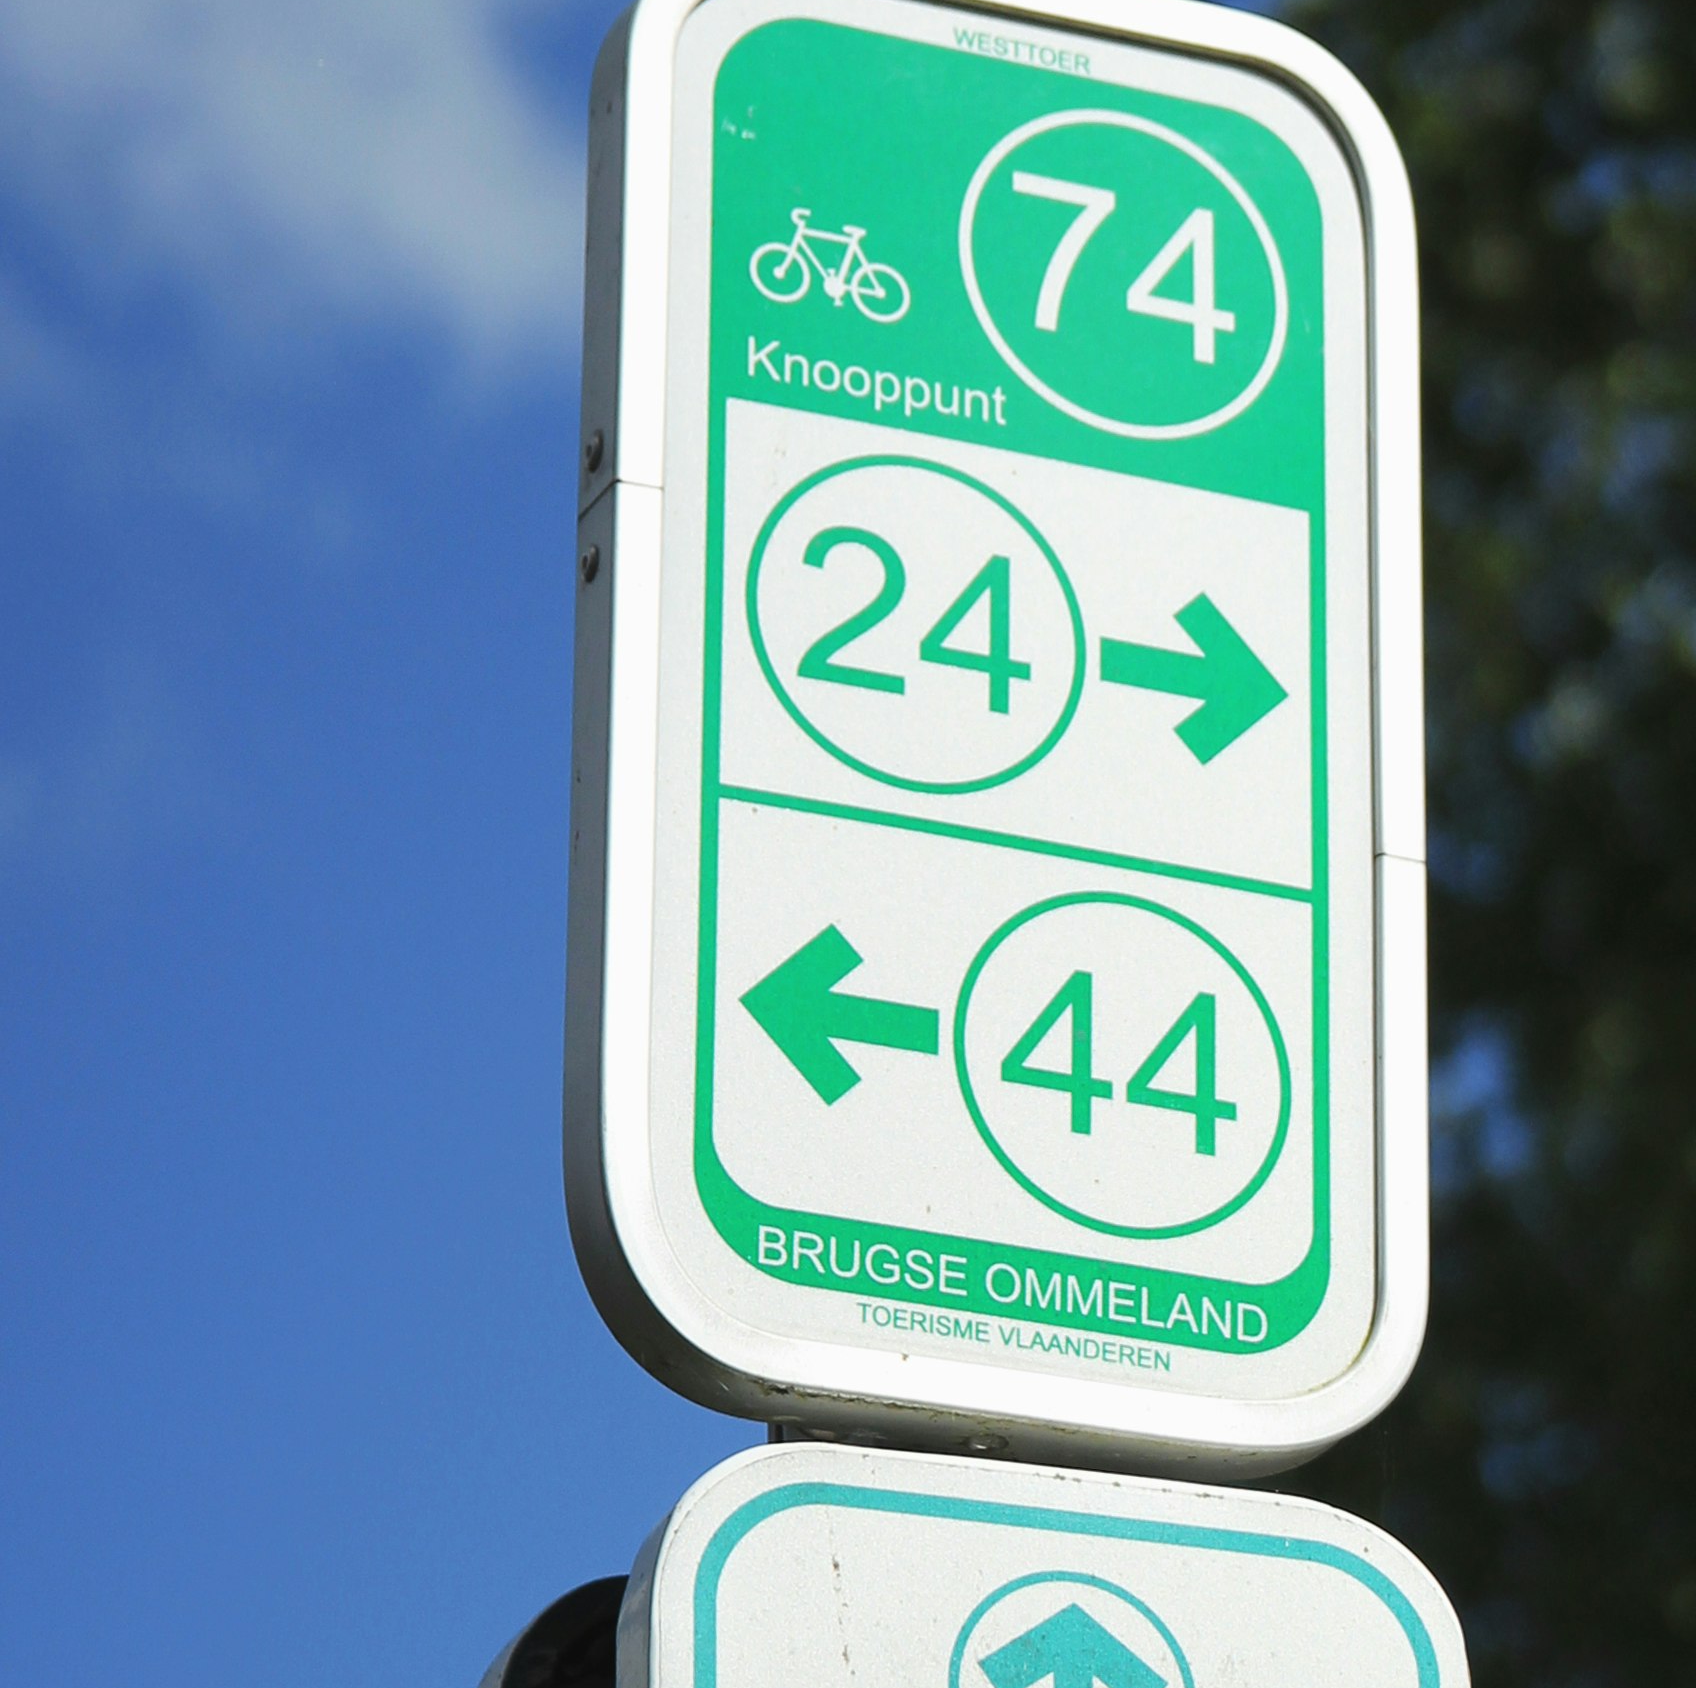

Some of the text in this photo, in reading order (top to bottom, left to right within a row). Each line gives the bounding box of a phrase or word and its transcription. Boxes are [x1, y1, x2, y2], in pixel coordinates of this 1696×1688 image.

[953, 26, 1091, 75] WESTTOER
[1011, 171, 1237, 365] 74
[747, 335, 1007, 426] Knooppunt
[796, 525, 1032, 716] 24
[1000, 969, 1238, 1157] 44
[757, 1225, 1269, 1344] BRUGSE OMMELAND
[856, 1302, 1171, 1372] TOERISME VLAANDEREN
